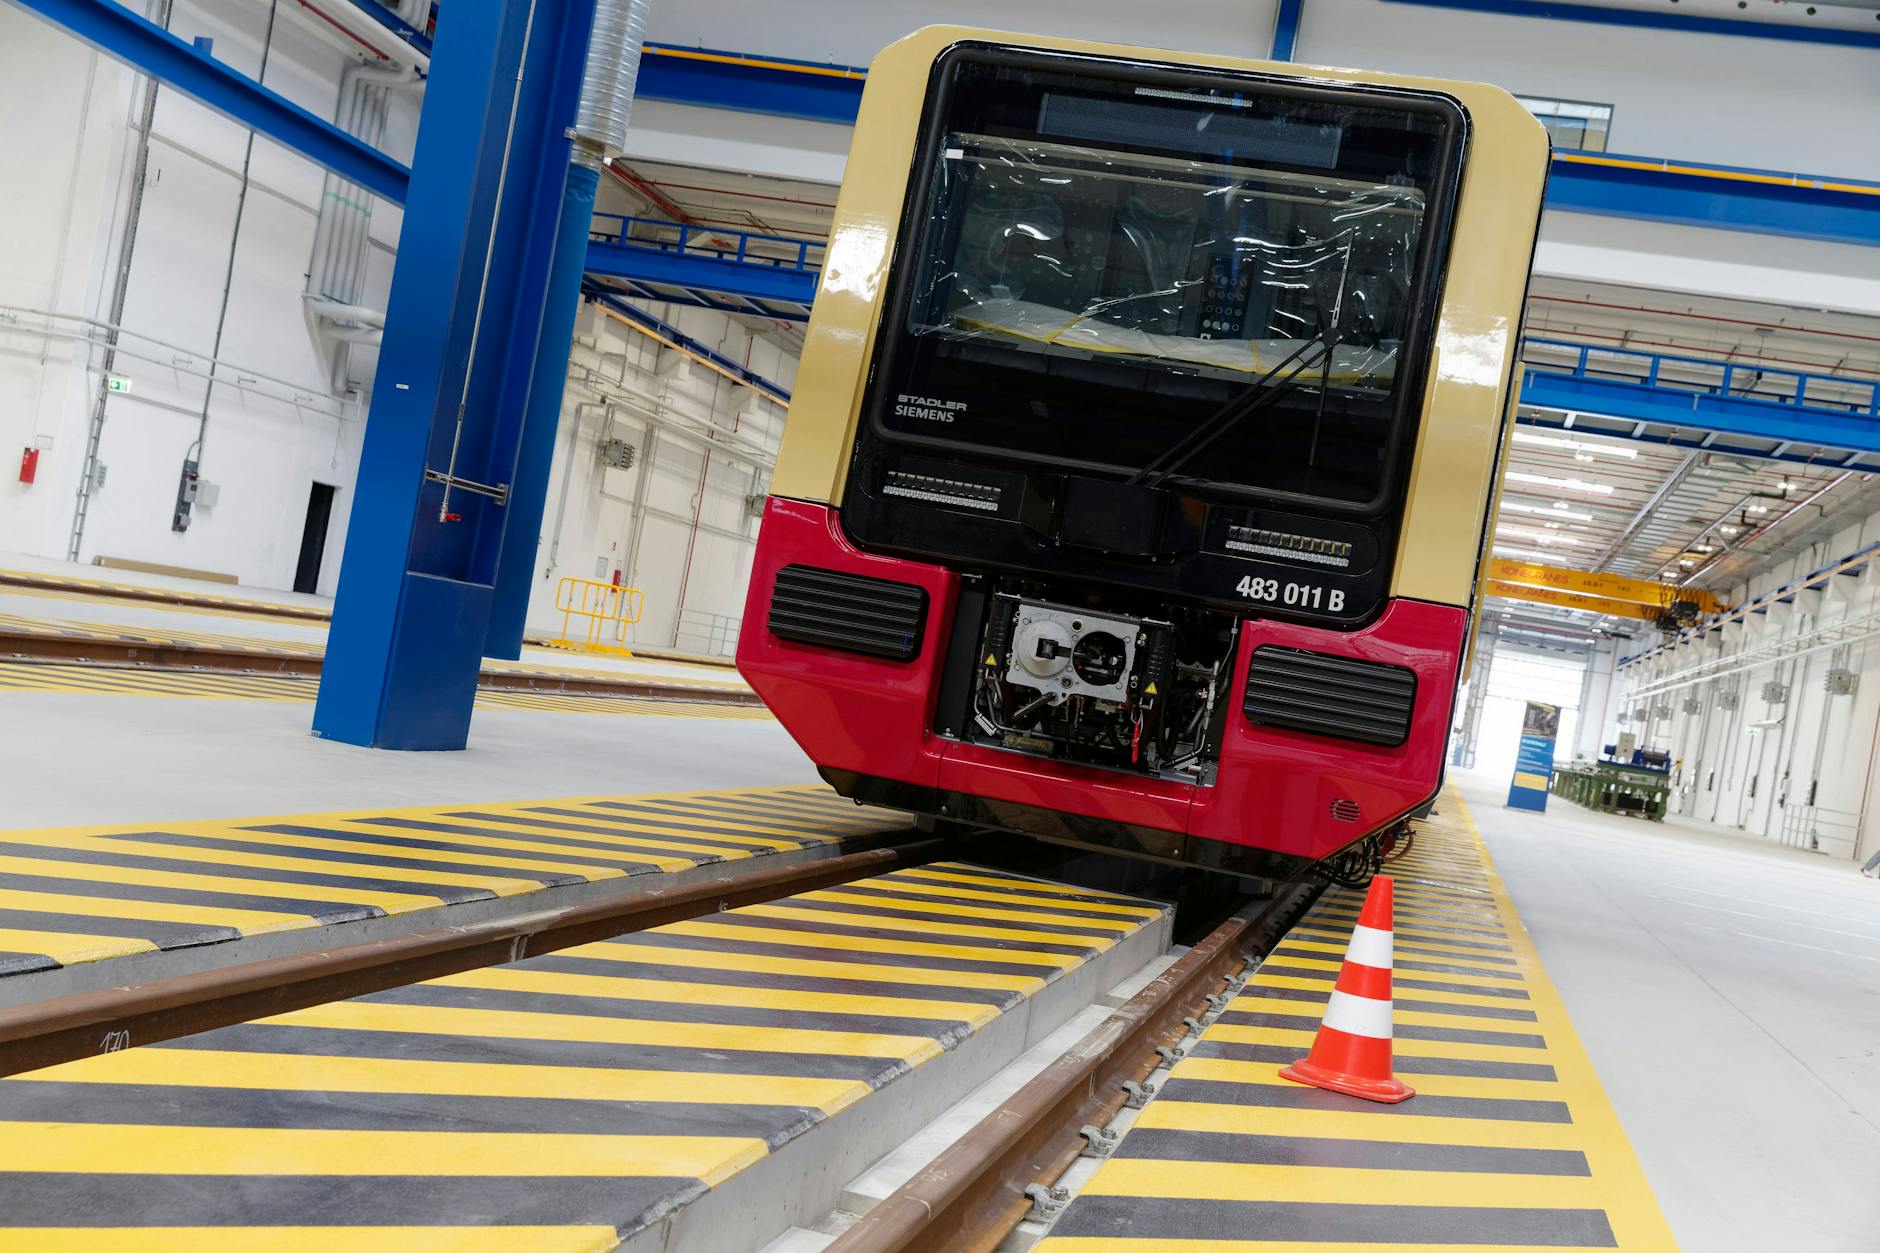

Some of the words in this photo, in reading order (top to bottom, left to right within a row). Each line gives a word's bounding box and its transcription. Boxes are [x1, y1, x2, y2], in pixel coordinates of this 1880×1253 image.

[897, 394, 968, 412] STADLER
[895, 404, 954, 422] SIEMENS
[1235, 575, 1279, 602] 483
[1283, 582, 1322, 609] 011
[1327, 588, 1346, 612] B
